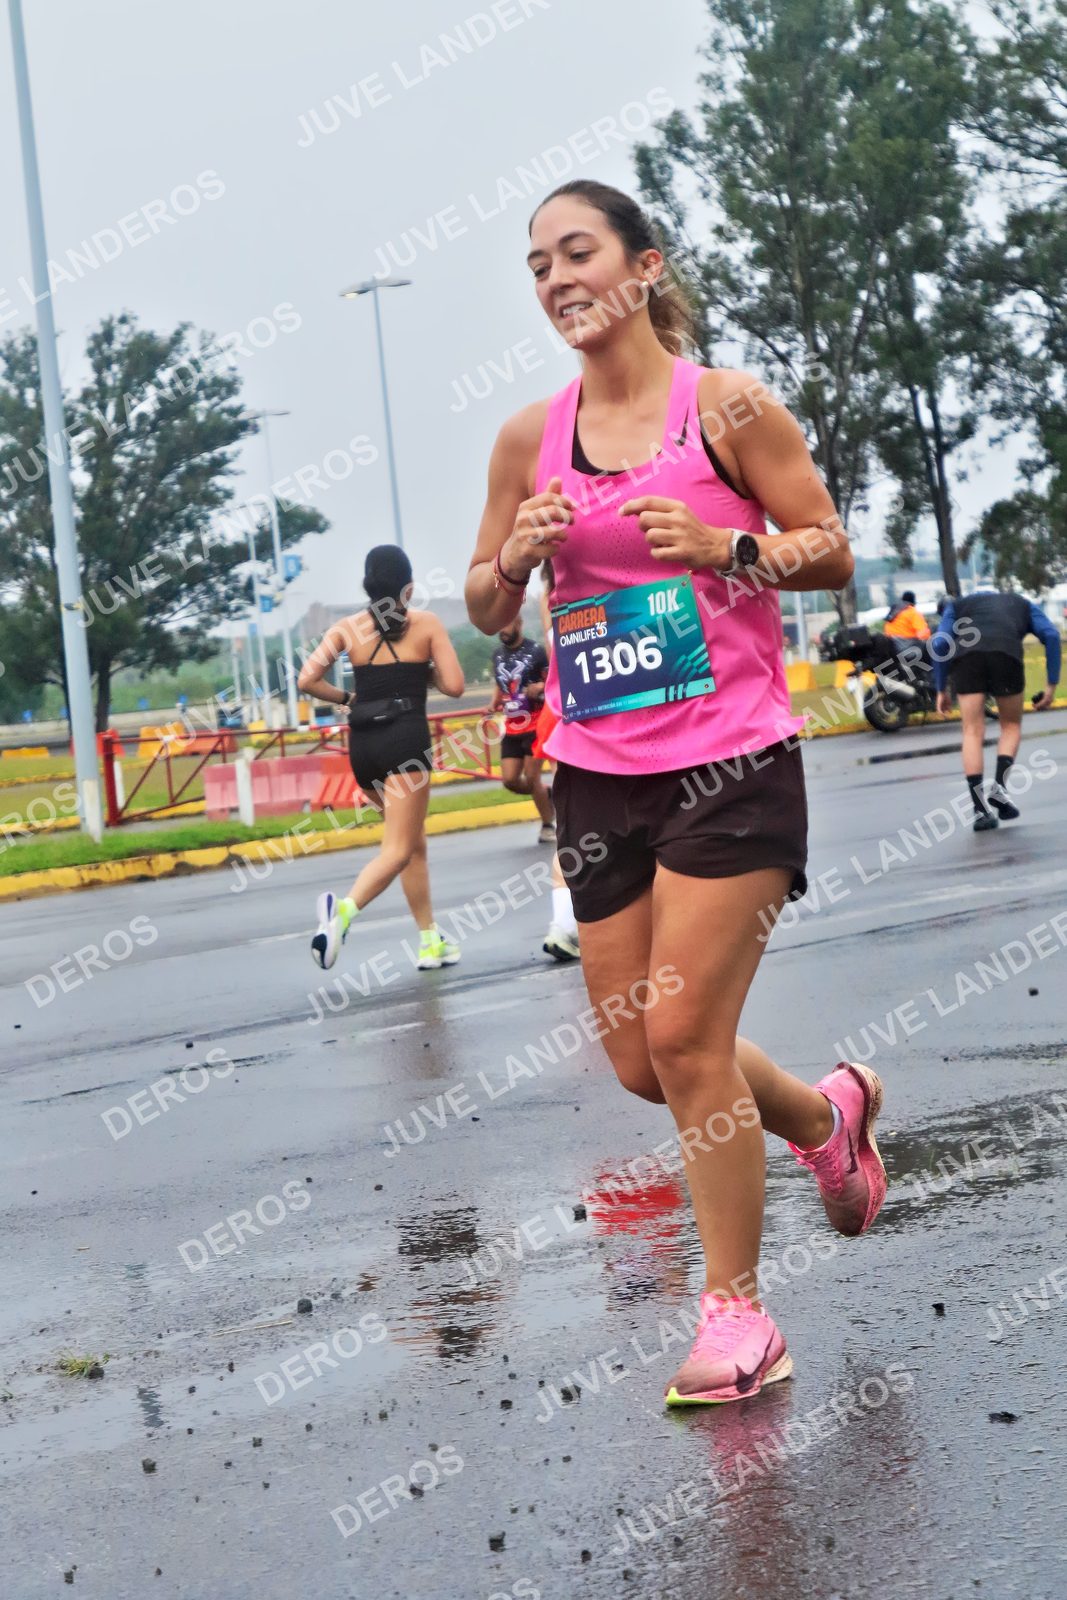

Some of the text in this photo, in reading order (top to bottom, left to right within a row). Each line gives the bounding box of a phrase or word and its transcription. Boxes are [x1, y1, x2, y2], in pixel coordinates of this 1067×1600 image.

[647, 587, 680, 616] 10K
[558, 605, 607, 634] CARRERA
[574, 635, 663, 684] 1306
